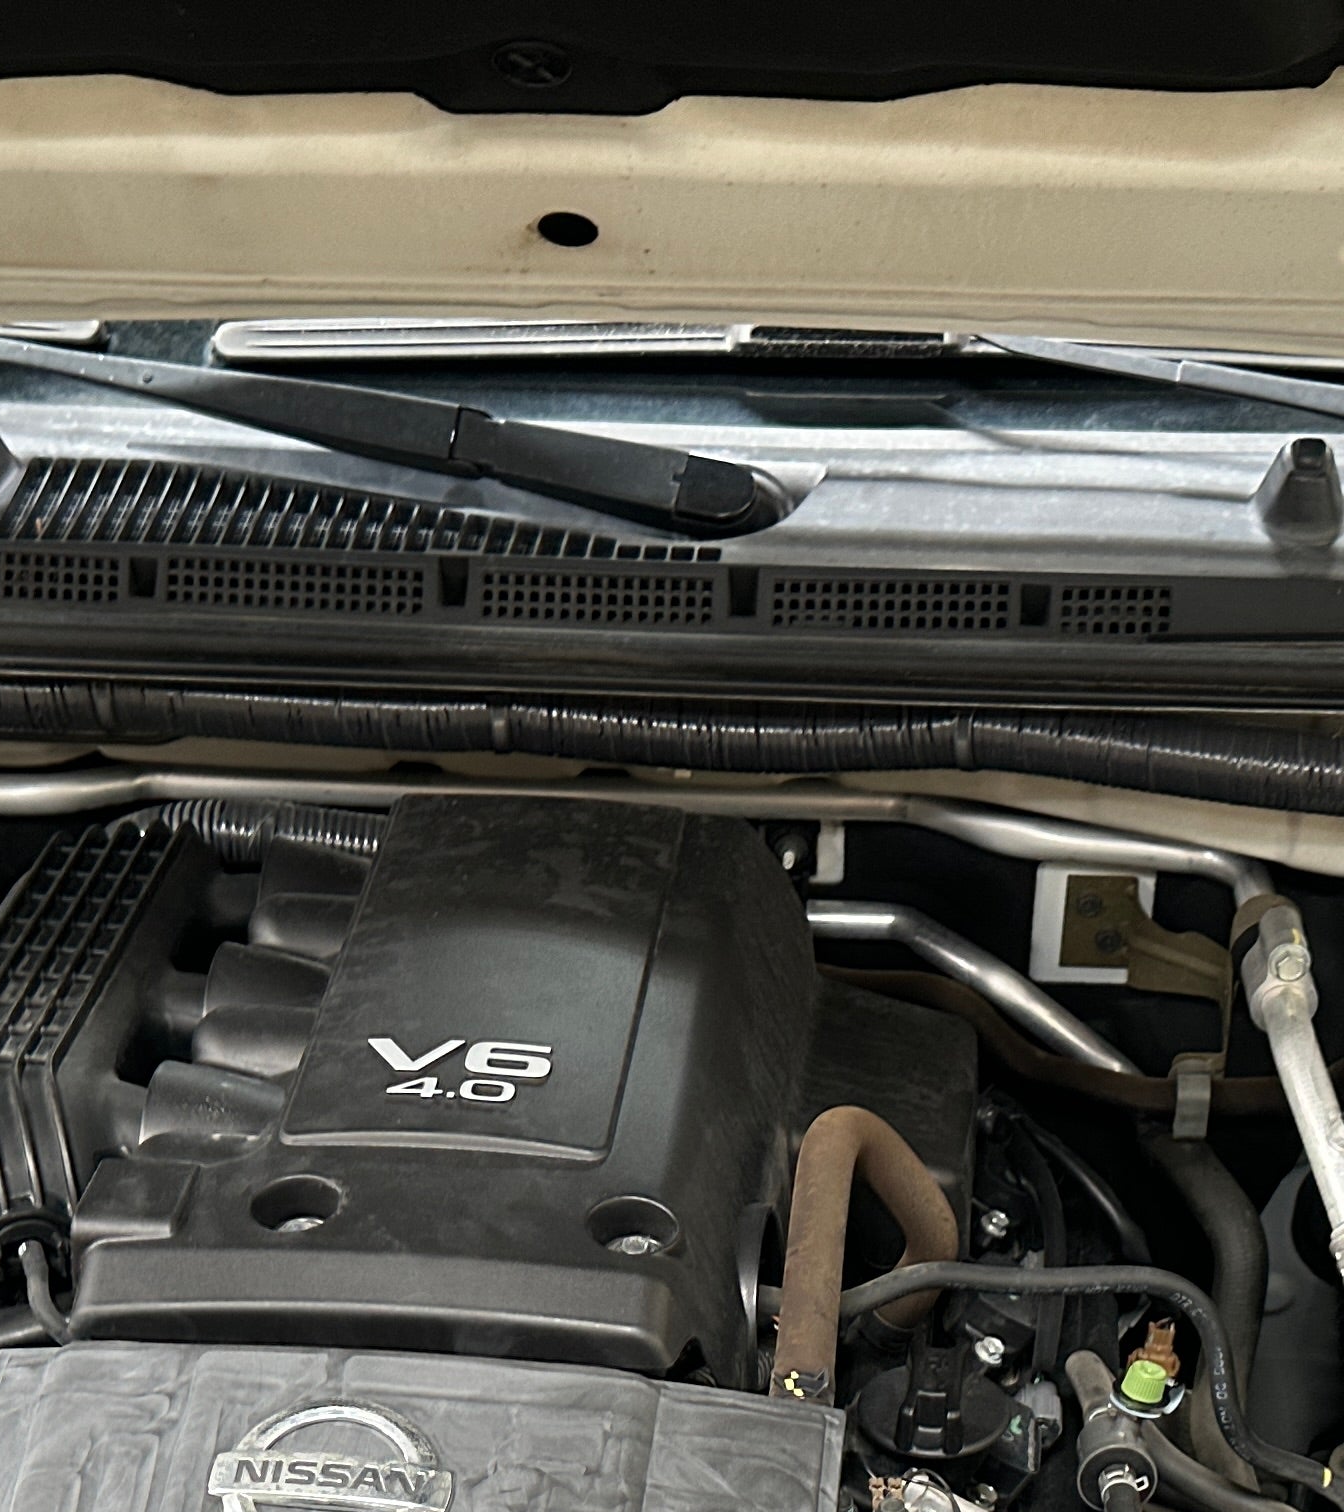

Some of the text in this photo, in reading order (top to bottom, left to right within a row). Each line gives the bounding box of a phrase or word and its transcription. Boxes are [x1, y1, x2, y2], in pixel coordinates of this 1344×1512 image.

[367, 1037, 553, 1079] V6
[385, 1076, 517, 1102] 4.0
[233, 1458, 430, 1497] NISSAN
